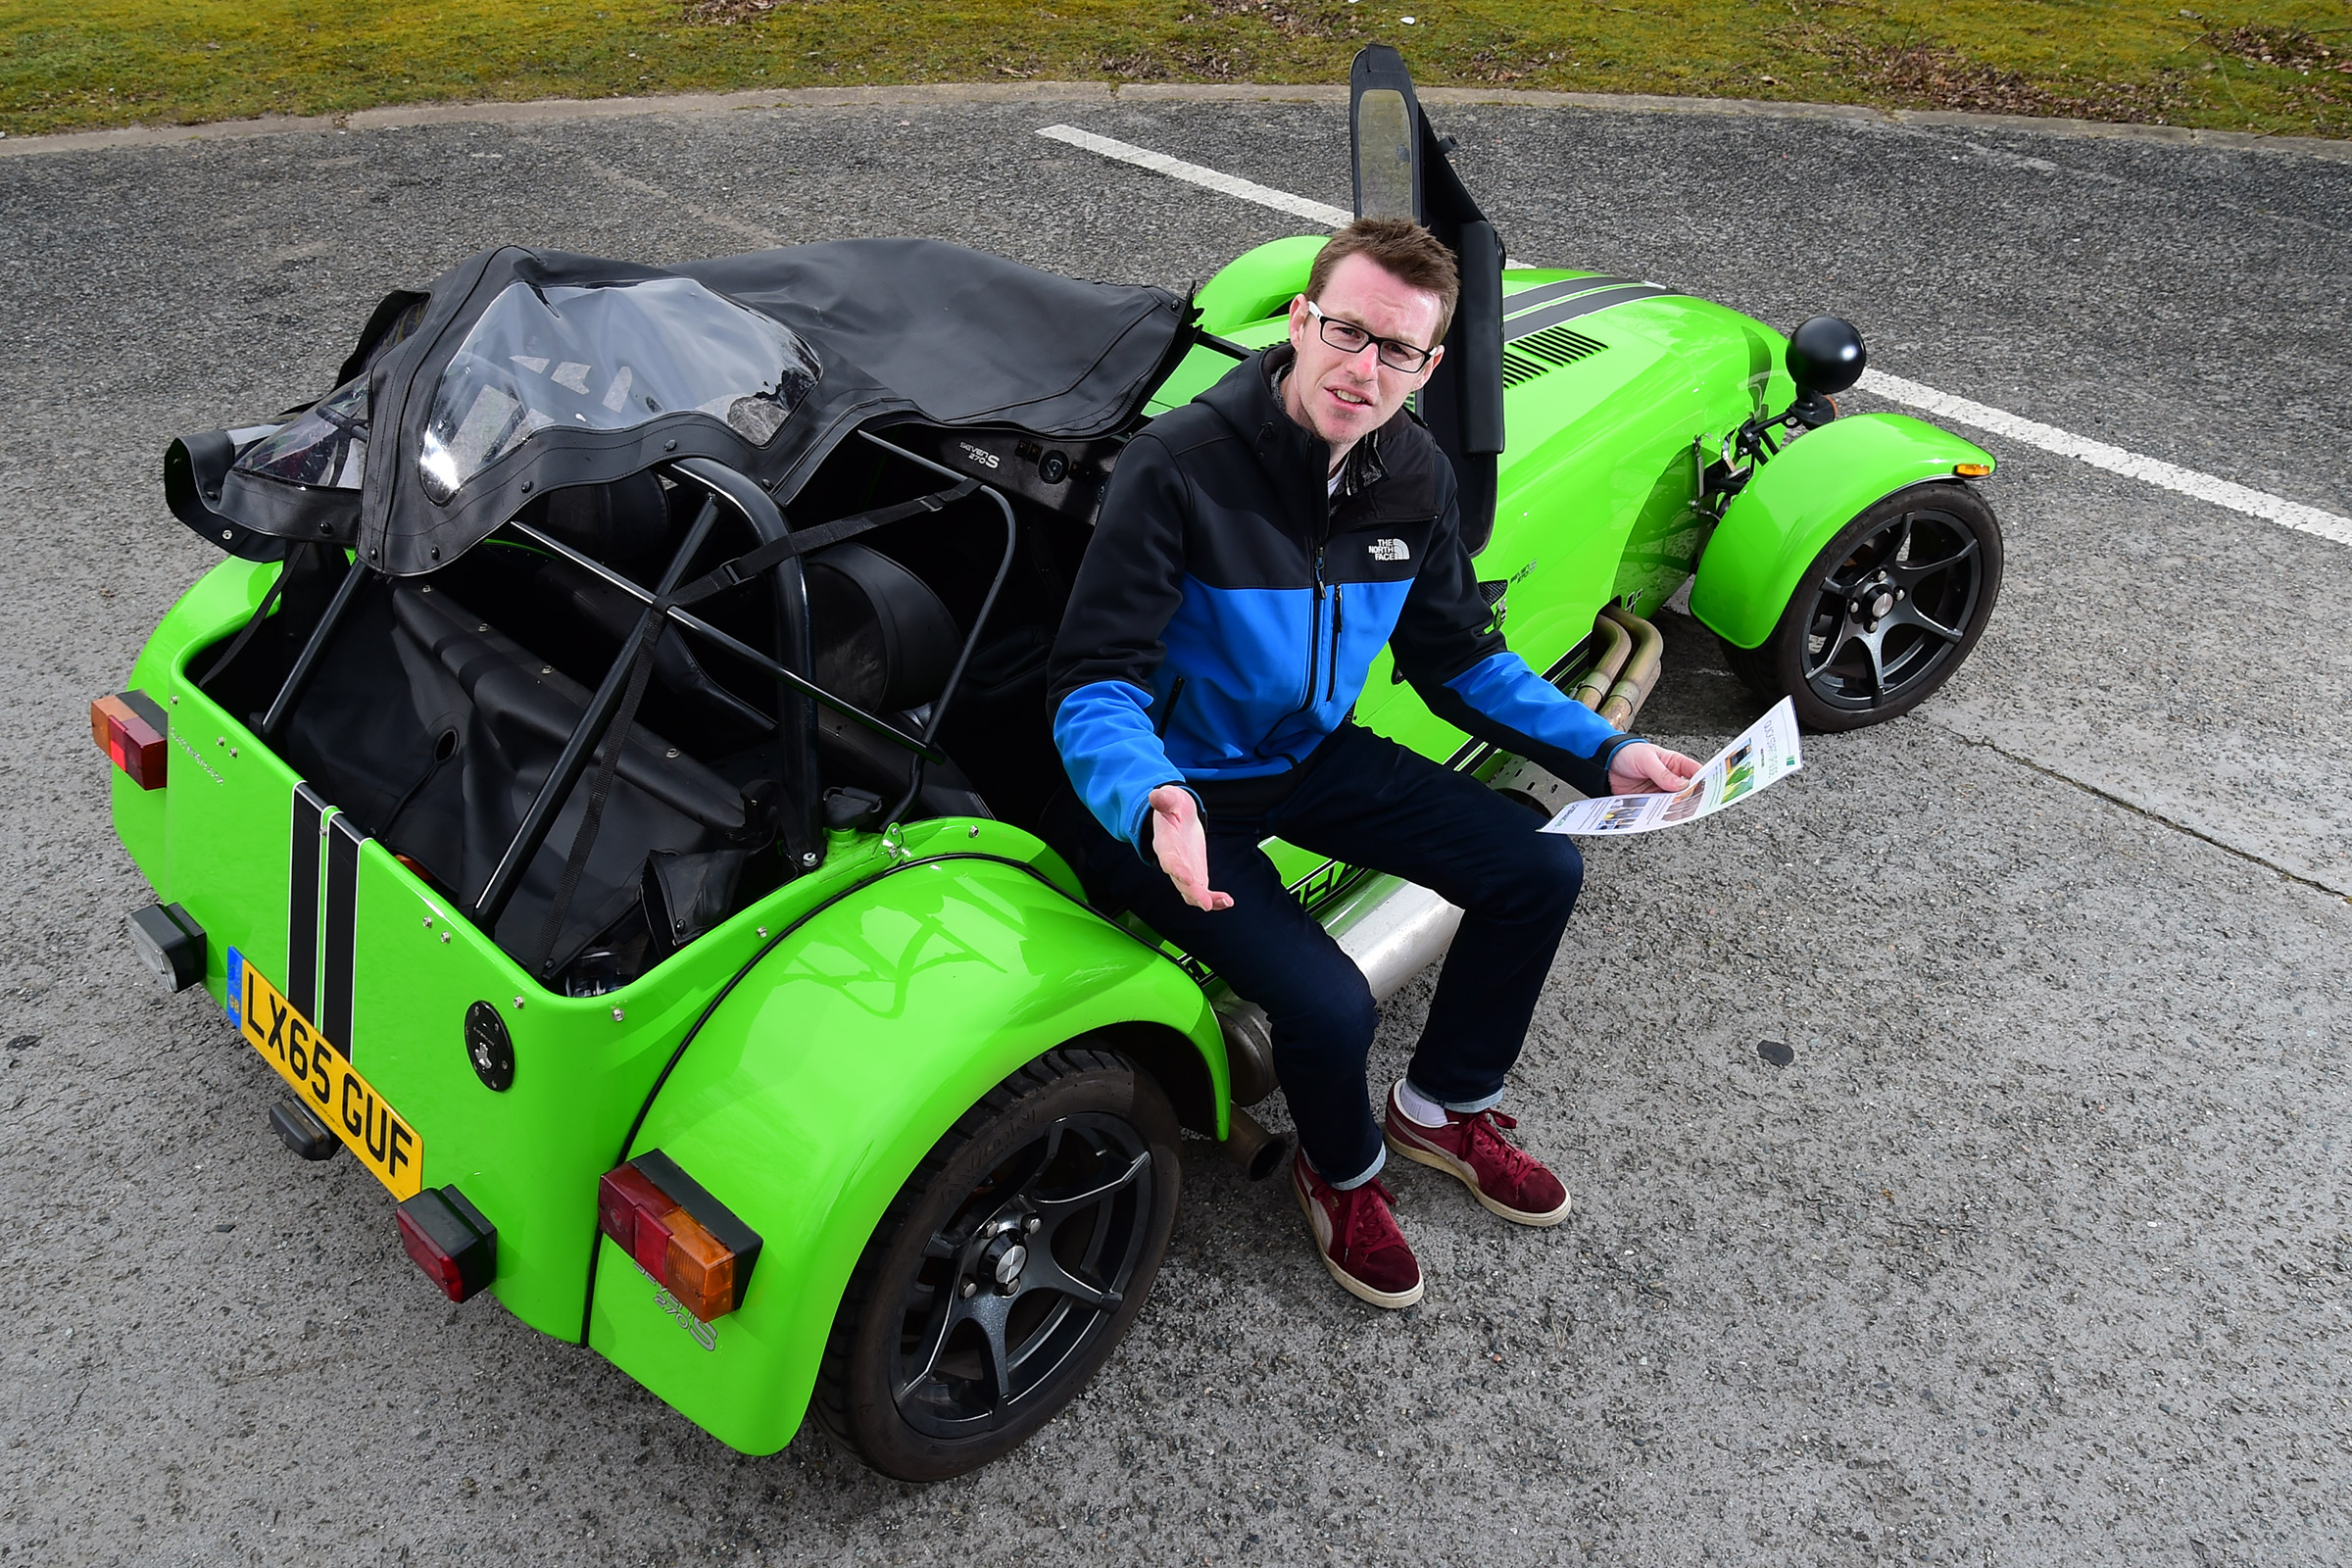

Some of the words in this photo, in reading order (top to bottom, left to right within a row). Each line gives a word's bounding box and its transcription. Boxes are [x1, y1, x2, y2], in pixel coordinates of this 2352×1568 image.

[1368, 545, 1394, 554] NORTH
[1377, 538, 1393, 547] THE
[248, 971, 331, 1105] LX65
[342, 1072, 413, 1178] GUF
[654, 1292, 689, 1329] 270
